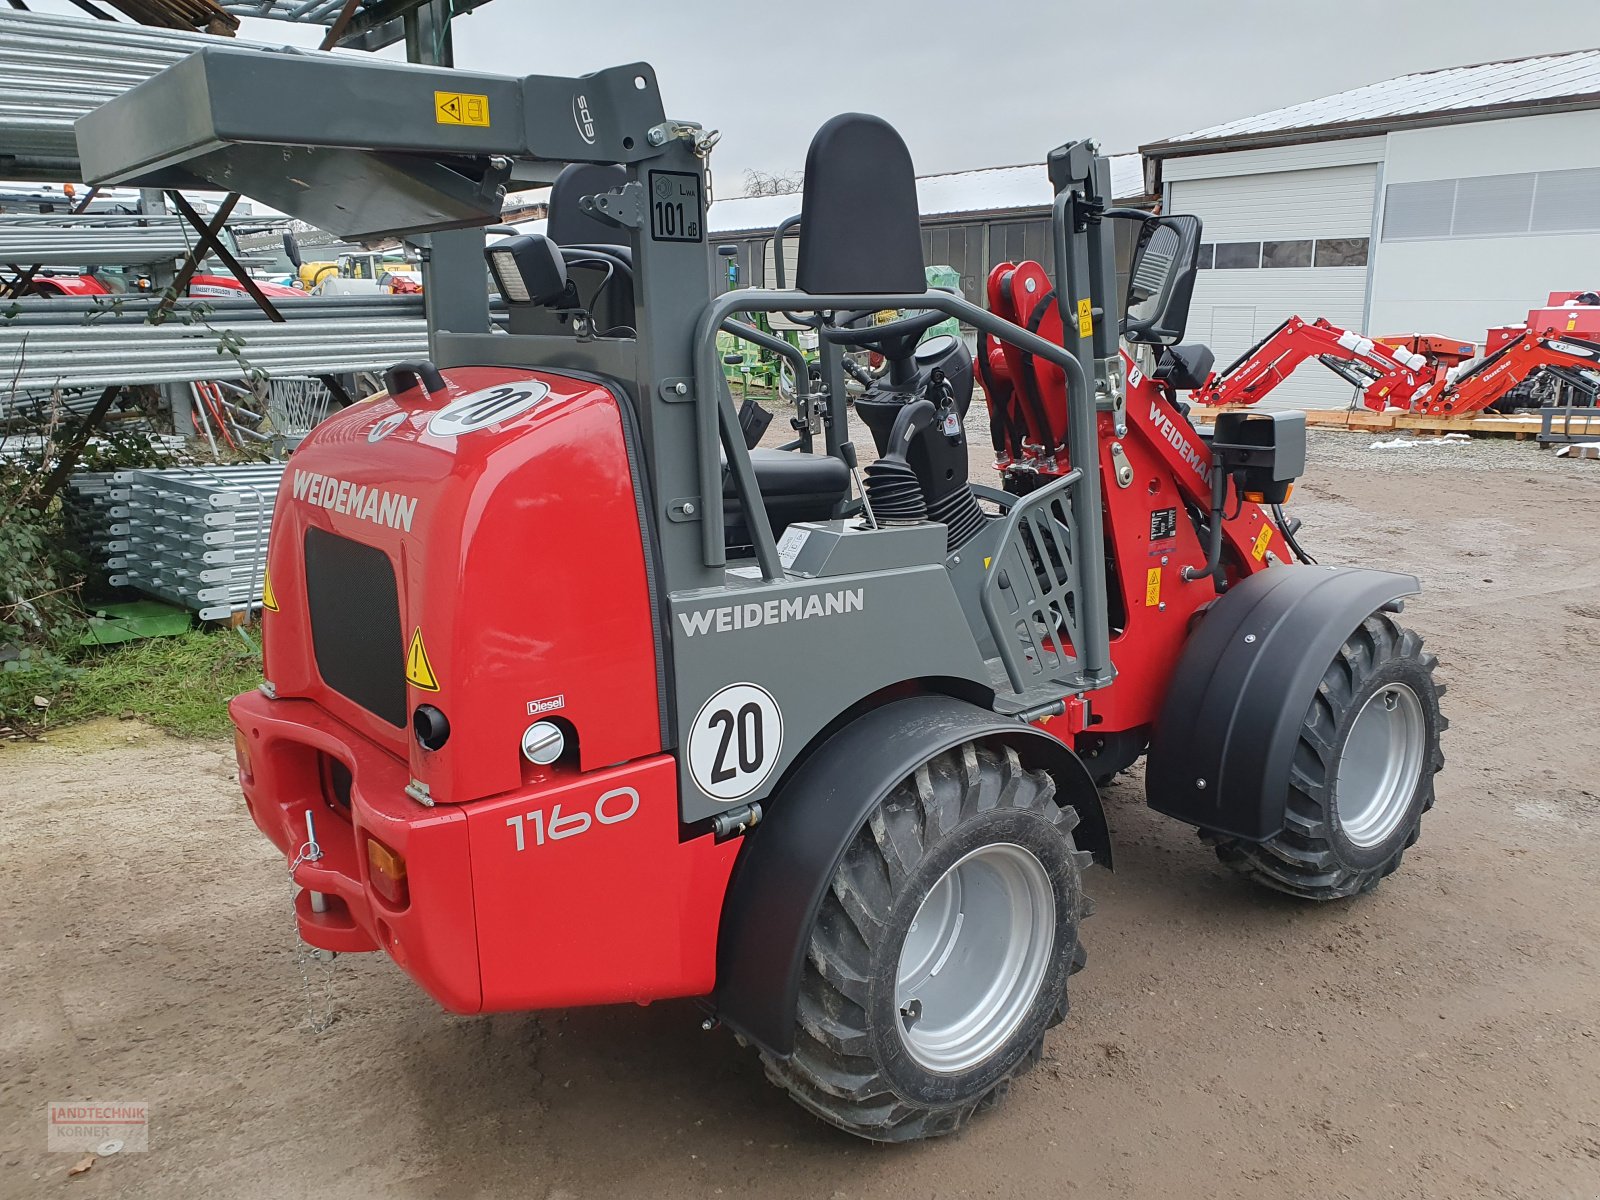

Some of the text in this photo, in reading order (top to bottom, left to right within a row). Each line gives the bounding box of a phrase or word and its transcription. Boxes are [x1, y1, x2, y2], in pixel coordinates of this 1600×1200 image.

[577, 94, 596, 138] eps
[656, 202, 698, 237] 101 dB
[1482, 360, 1512, 383] Quicke
[440, 387, 533, 426] 20
[293, 468, 418, 533] WEIDEMANN
[678, 588, 864, 638] WEIDEMANN
[529, 697, 562, 713] Diesel
[708, 702, 764, 785] 20
[506, 786, 639, 852] 1160
